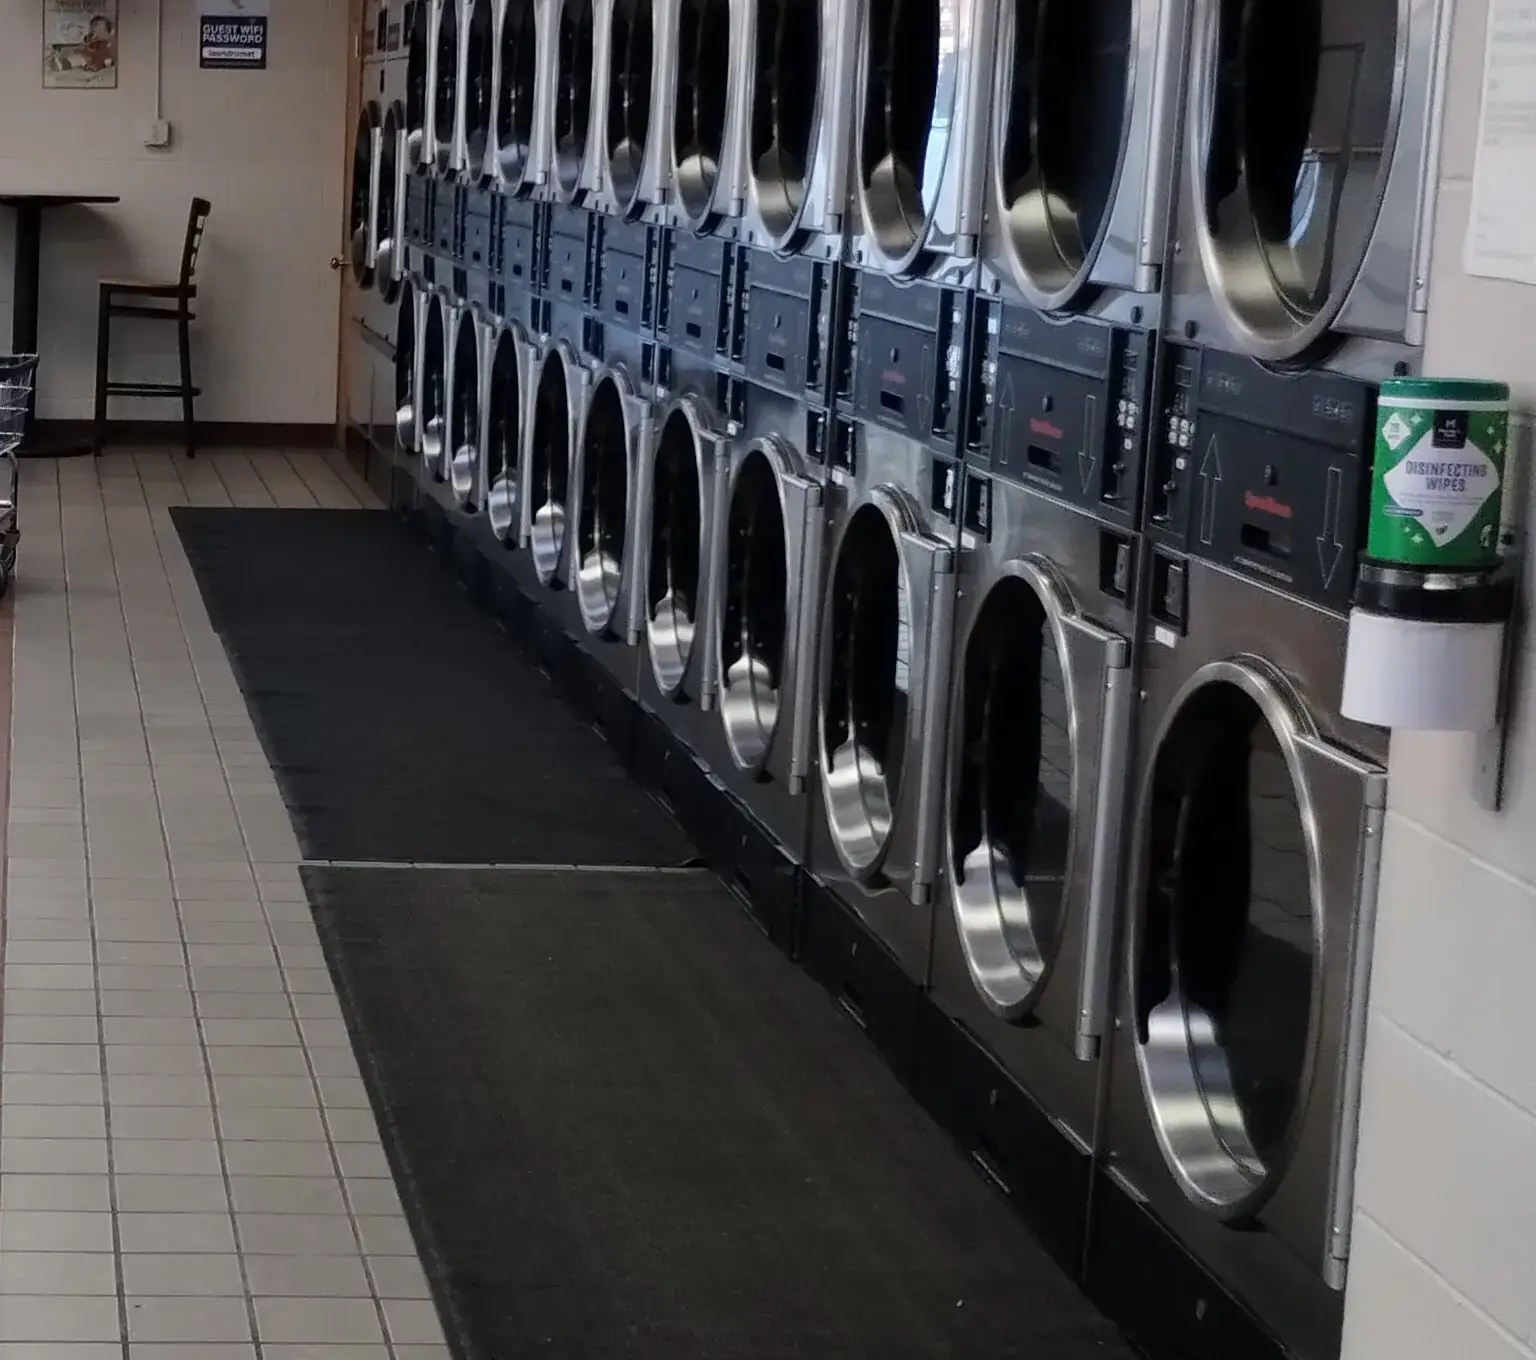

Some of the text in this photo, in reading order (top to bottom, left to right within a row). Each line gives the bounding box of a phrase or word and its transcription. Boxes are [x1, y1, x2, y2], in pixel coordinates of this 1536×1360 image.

[203, 24, 263, 35] GUEST WIFI
[203, 34, 262, 44] PASSWORD
[1405, 460, 1488, 478] DISINFECTING
[1425, 477, 1467, 492] WIPES
